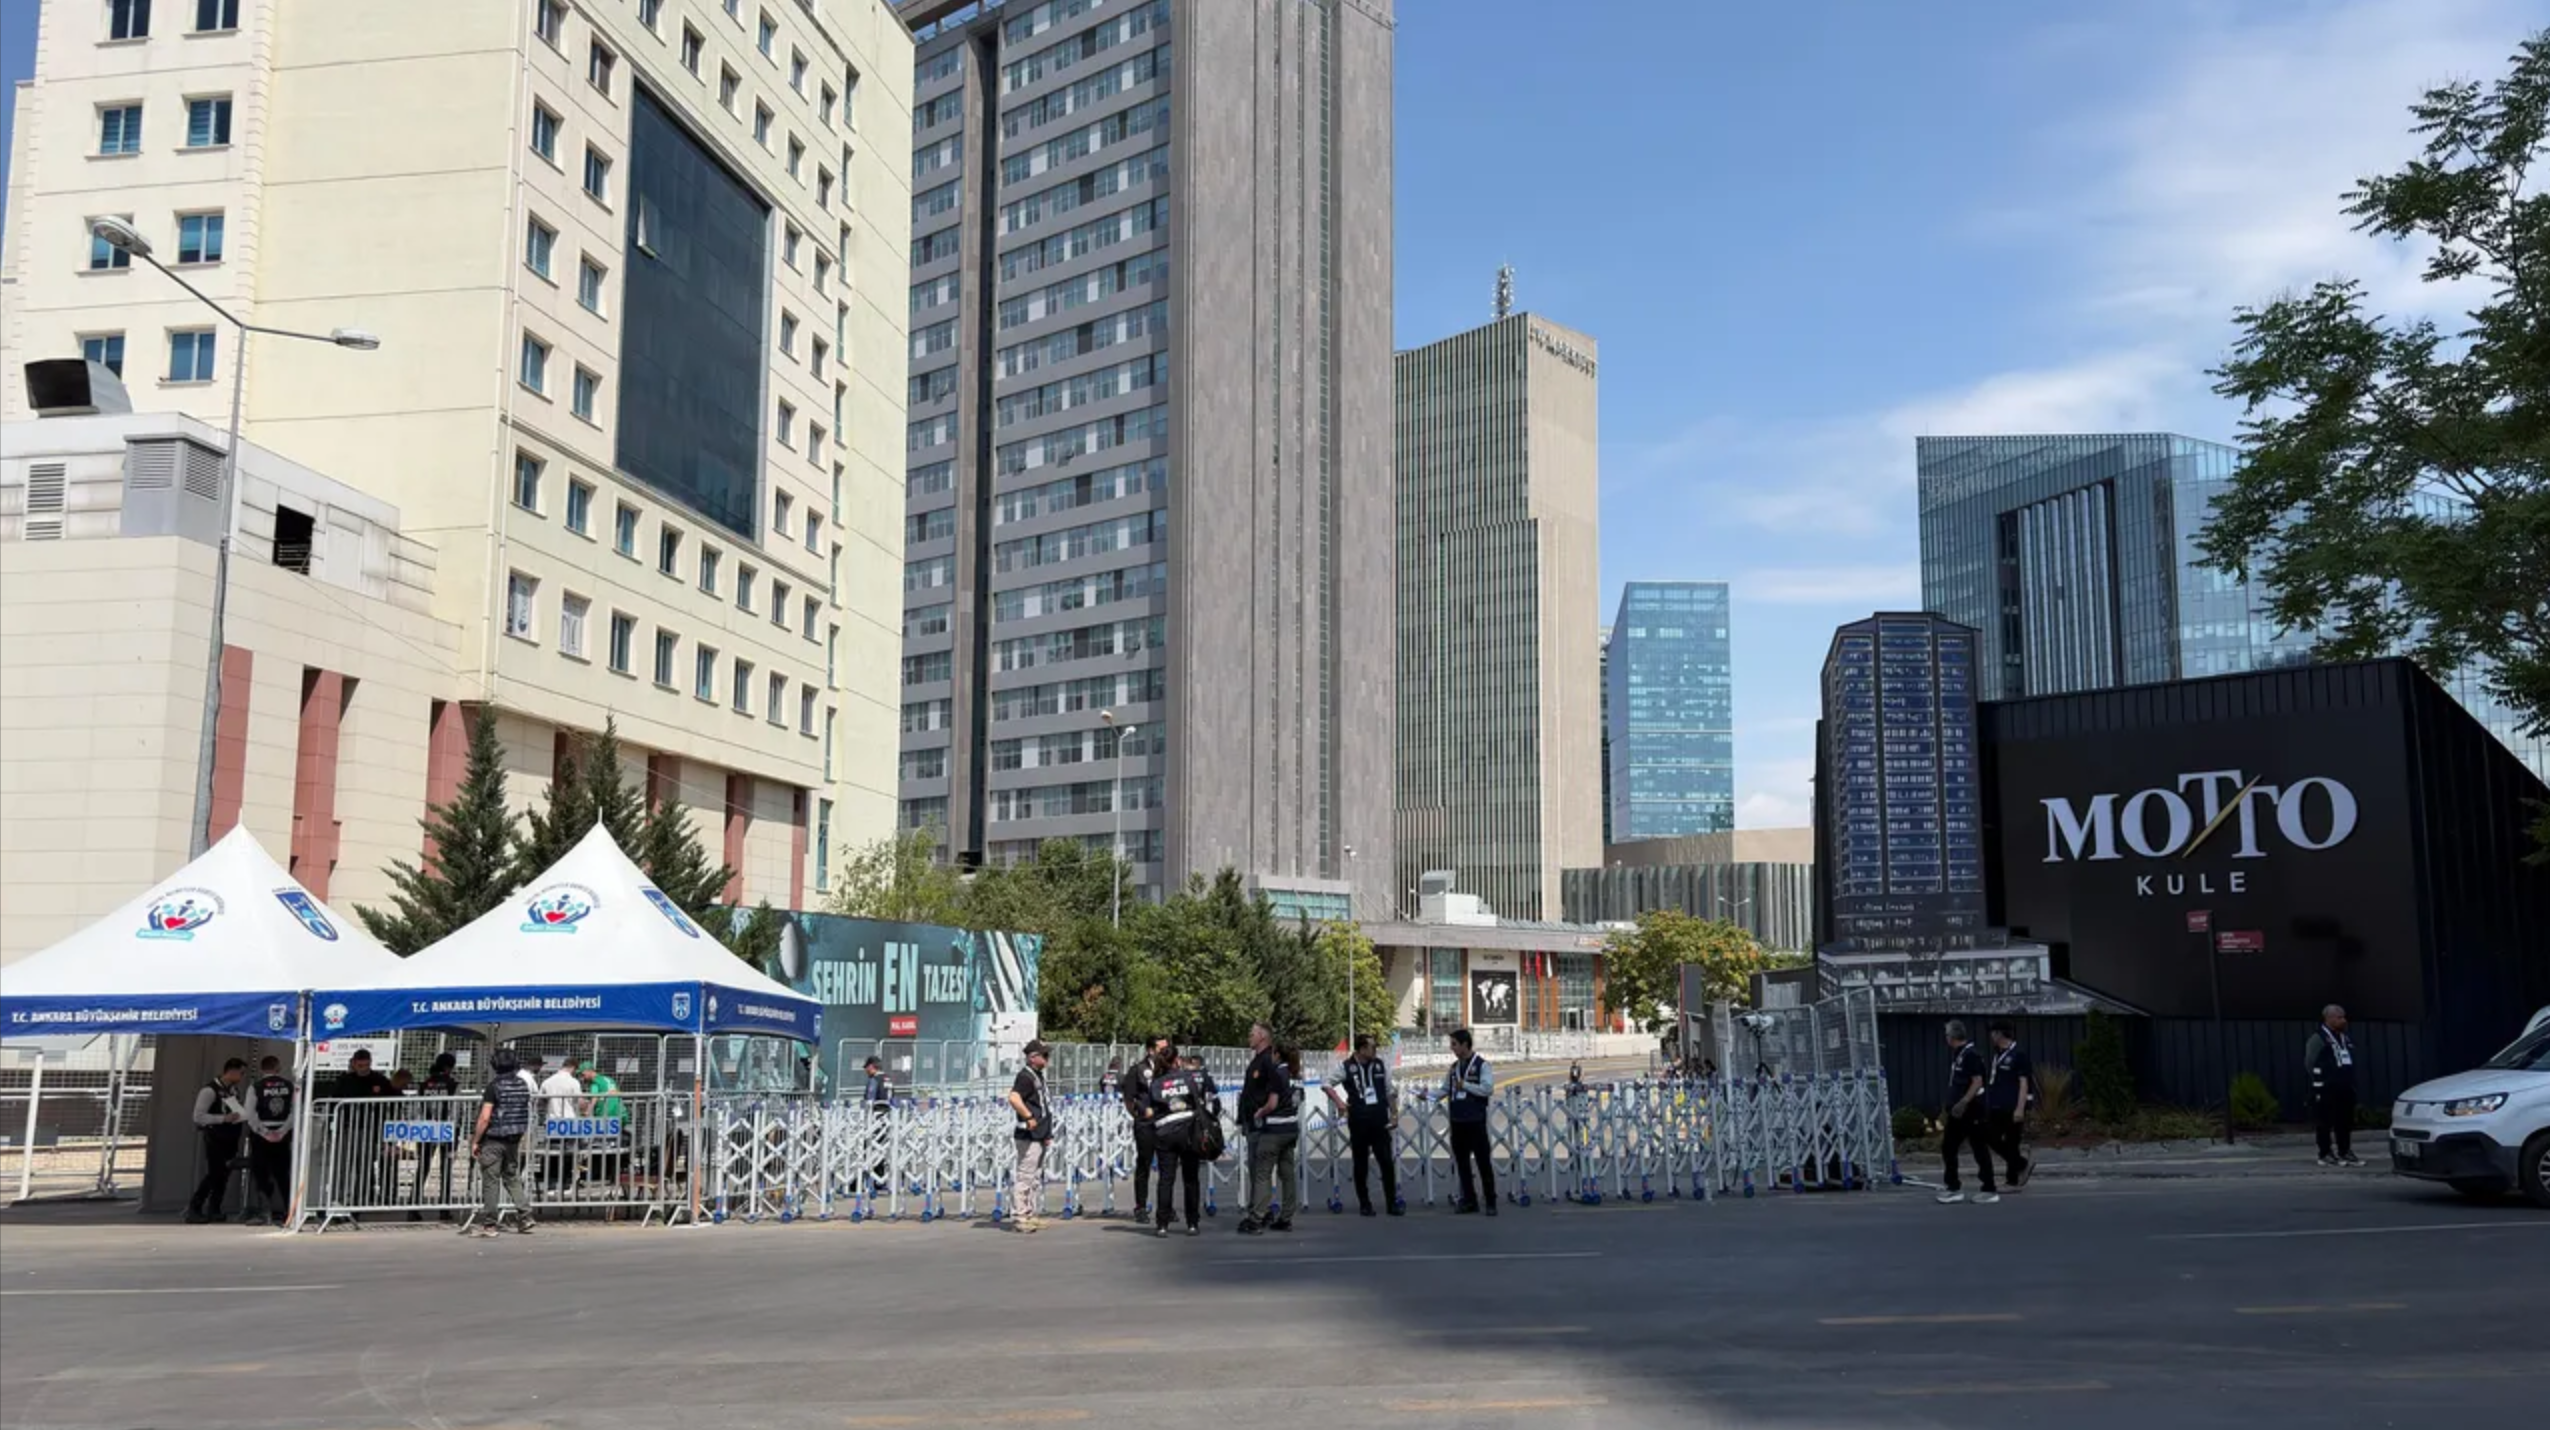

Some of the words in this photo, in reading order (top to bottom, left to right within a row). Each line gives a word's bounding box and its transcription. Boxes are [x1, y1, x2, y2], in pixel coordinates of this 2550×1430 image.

[2040, 769, 2358, 863] MOTTO
[2136, 871, 2246, 896] KULE
[883, 941, 919, 1013] EN
[431, 1001, 475, 1012] ANKARA
[477, 996, 542, 1012] BÜYÜKŞEHİR
[543, 995, 601, 1009] BELEDİYESİ
